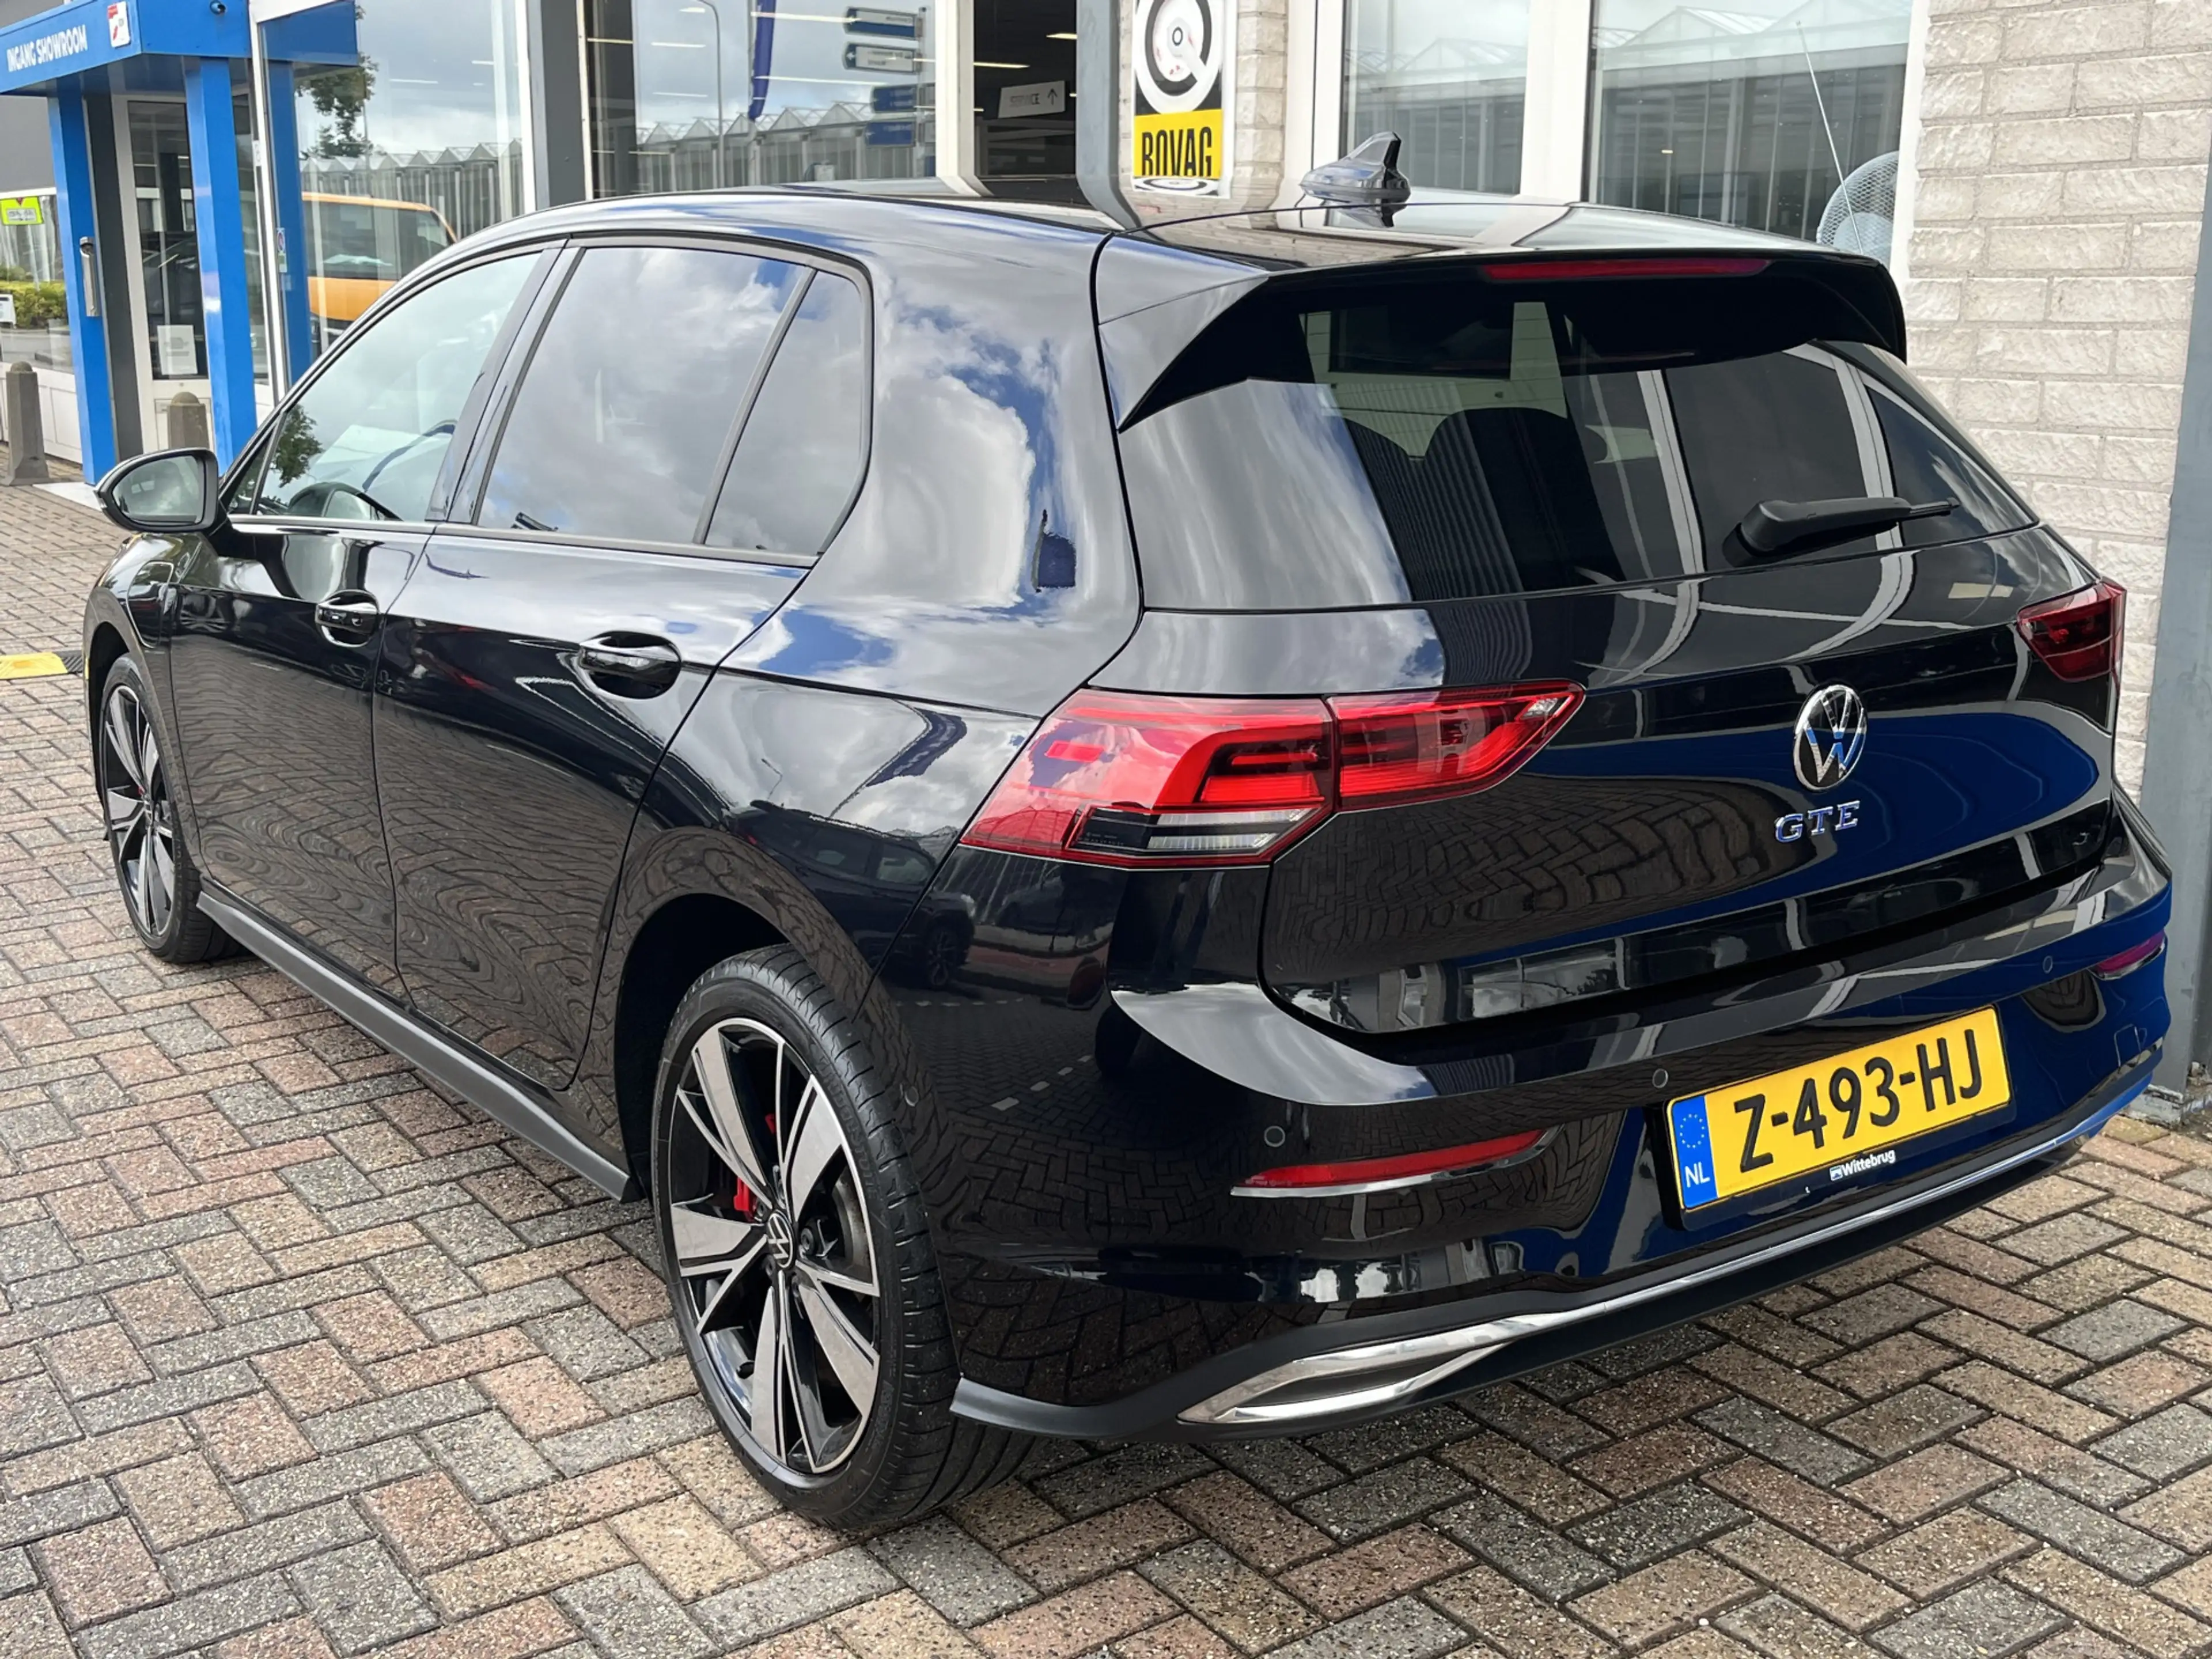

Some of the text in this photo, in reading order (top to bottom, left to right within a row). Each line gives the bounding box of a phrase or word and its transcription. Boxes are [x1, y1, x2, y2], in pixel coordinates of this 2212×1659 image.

[6, 24, 88, 72] INGANG SHOWROOM
[1775, 800, 1861, 843] GTE
[1734, 1029, 1982, 1173] Z-493-HJ
[1685, 1161, 1710, 1188] NL
[1842, 1150, 1896, 1176] Wittebrug
